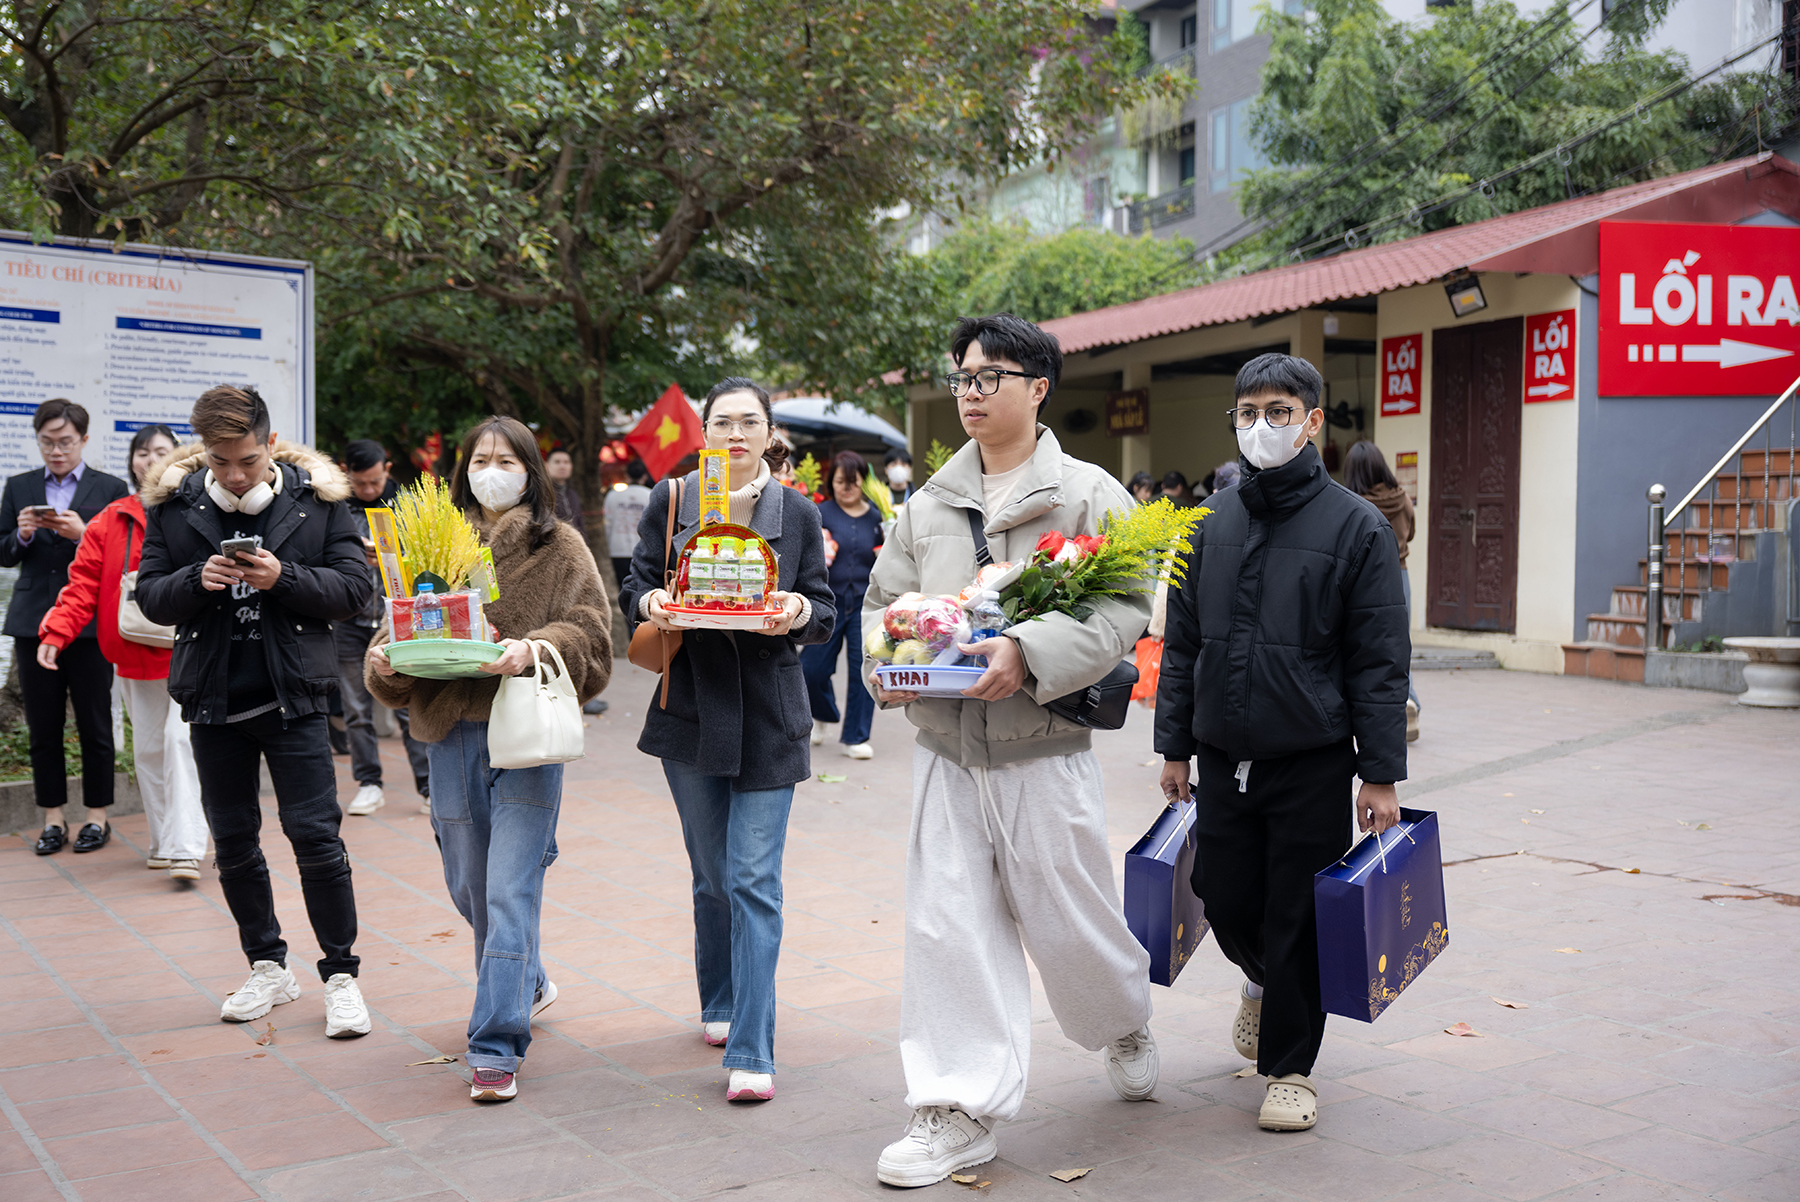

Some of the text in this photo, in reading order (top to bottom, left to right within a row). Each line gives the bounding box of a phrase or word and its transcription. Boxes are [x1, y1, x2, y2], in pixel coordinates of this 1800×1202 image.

[4, 259, 183, 293] TIÊU CHÍ (CRITERIA)
[1619, 250, 1800, 326] LỐI RA
[1533, 315, 1568, 352] LỐI
[1387, 339, 1416, 372] LỐI
[1535, 353, 1565, 379] RA
[1388, 373, 1413, 396] RA
